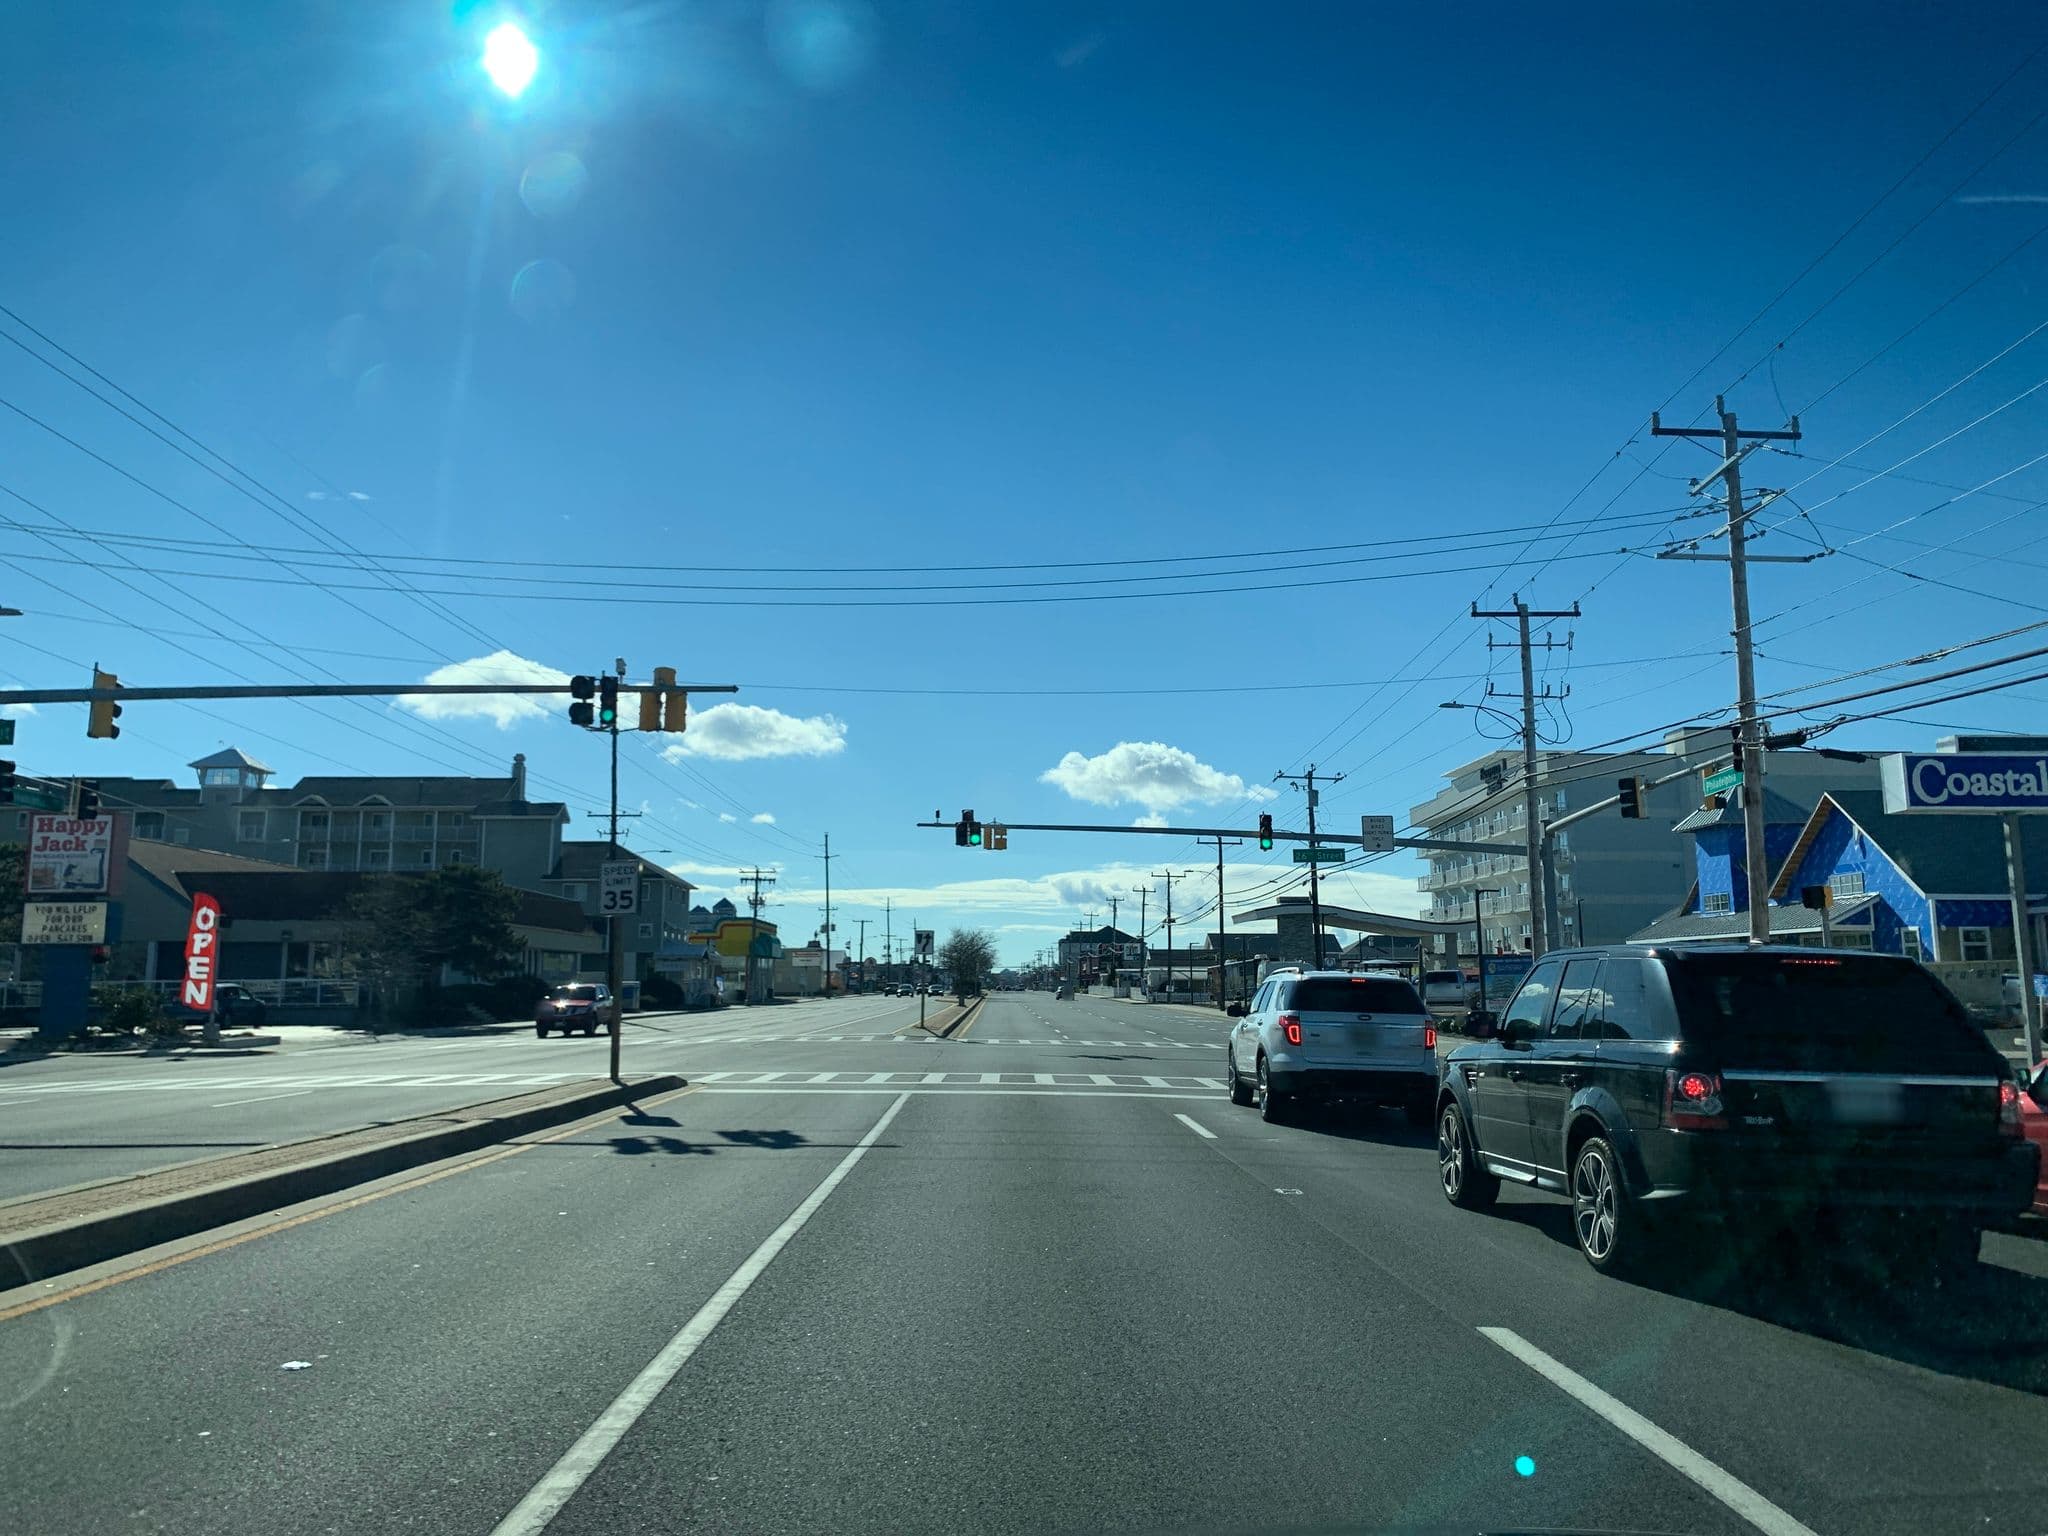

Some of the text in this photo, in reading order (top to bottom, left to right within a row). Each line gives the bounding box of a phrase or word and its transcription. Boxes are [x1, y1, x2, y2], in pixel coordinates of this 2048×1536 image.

[1912, 759, 2048, 804] Coastal
[36, 817, 109, 836] Happy
[34, 837, 88, 852] Jack
[603, 866, 637, 875] SPEED
[603, 890, 633, 910] 35
[42, 924, 88, 933] PANCAKES
[185, 906, 216, 1005] OPEN
